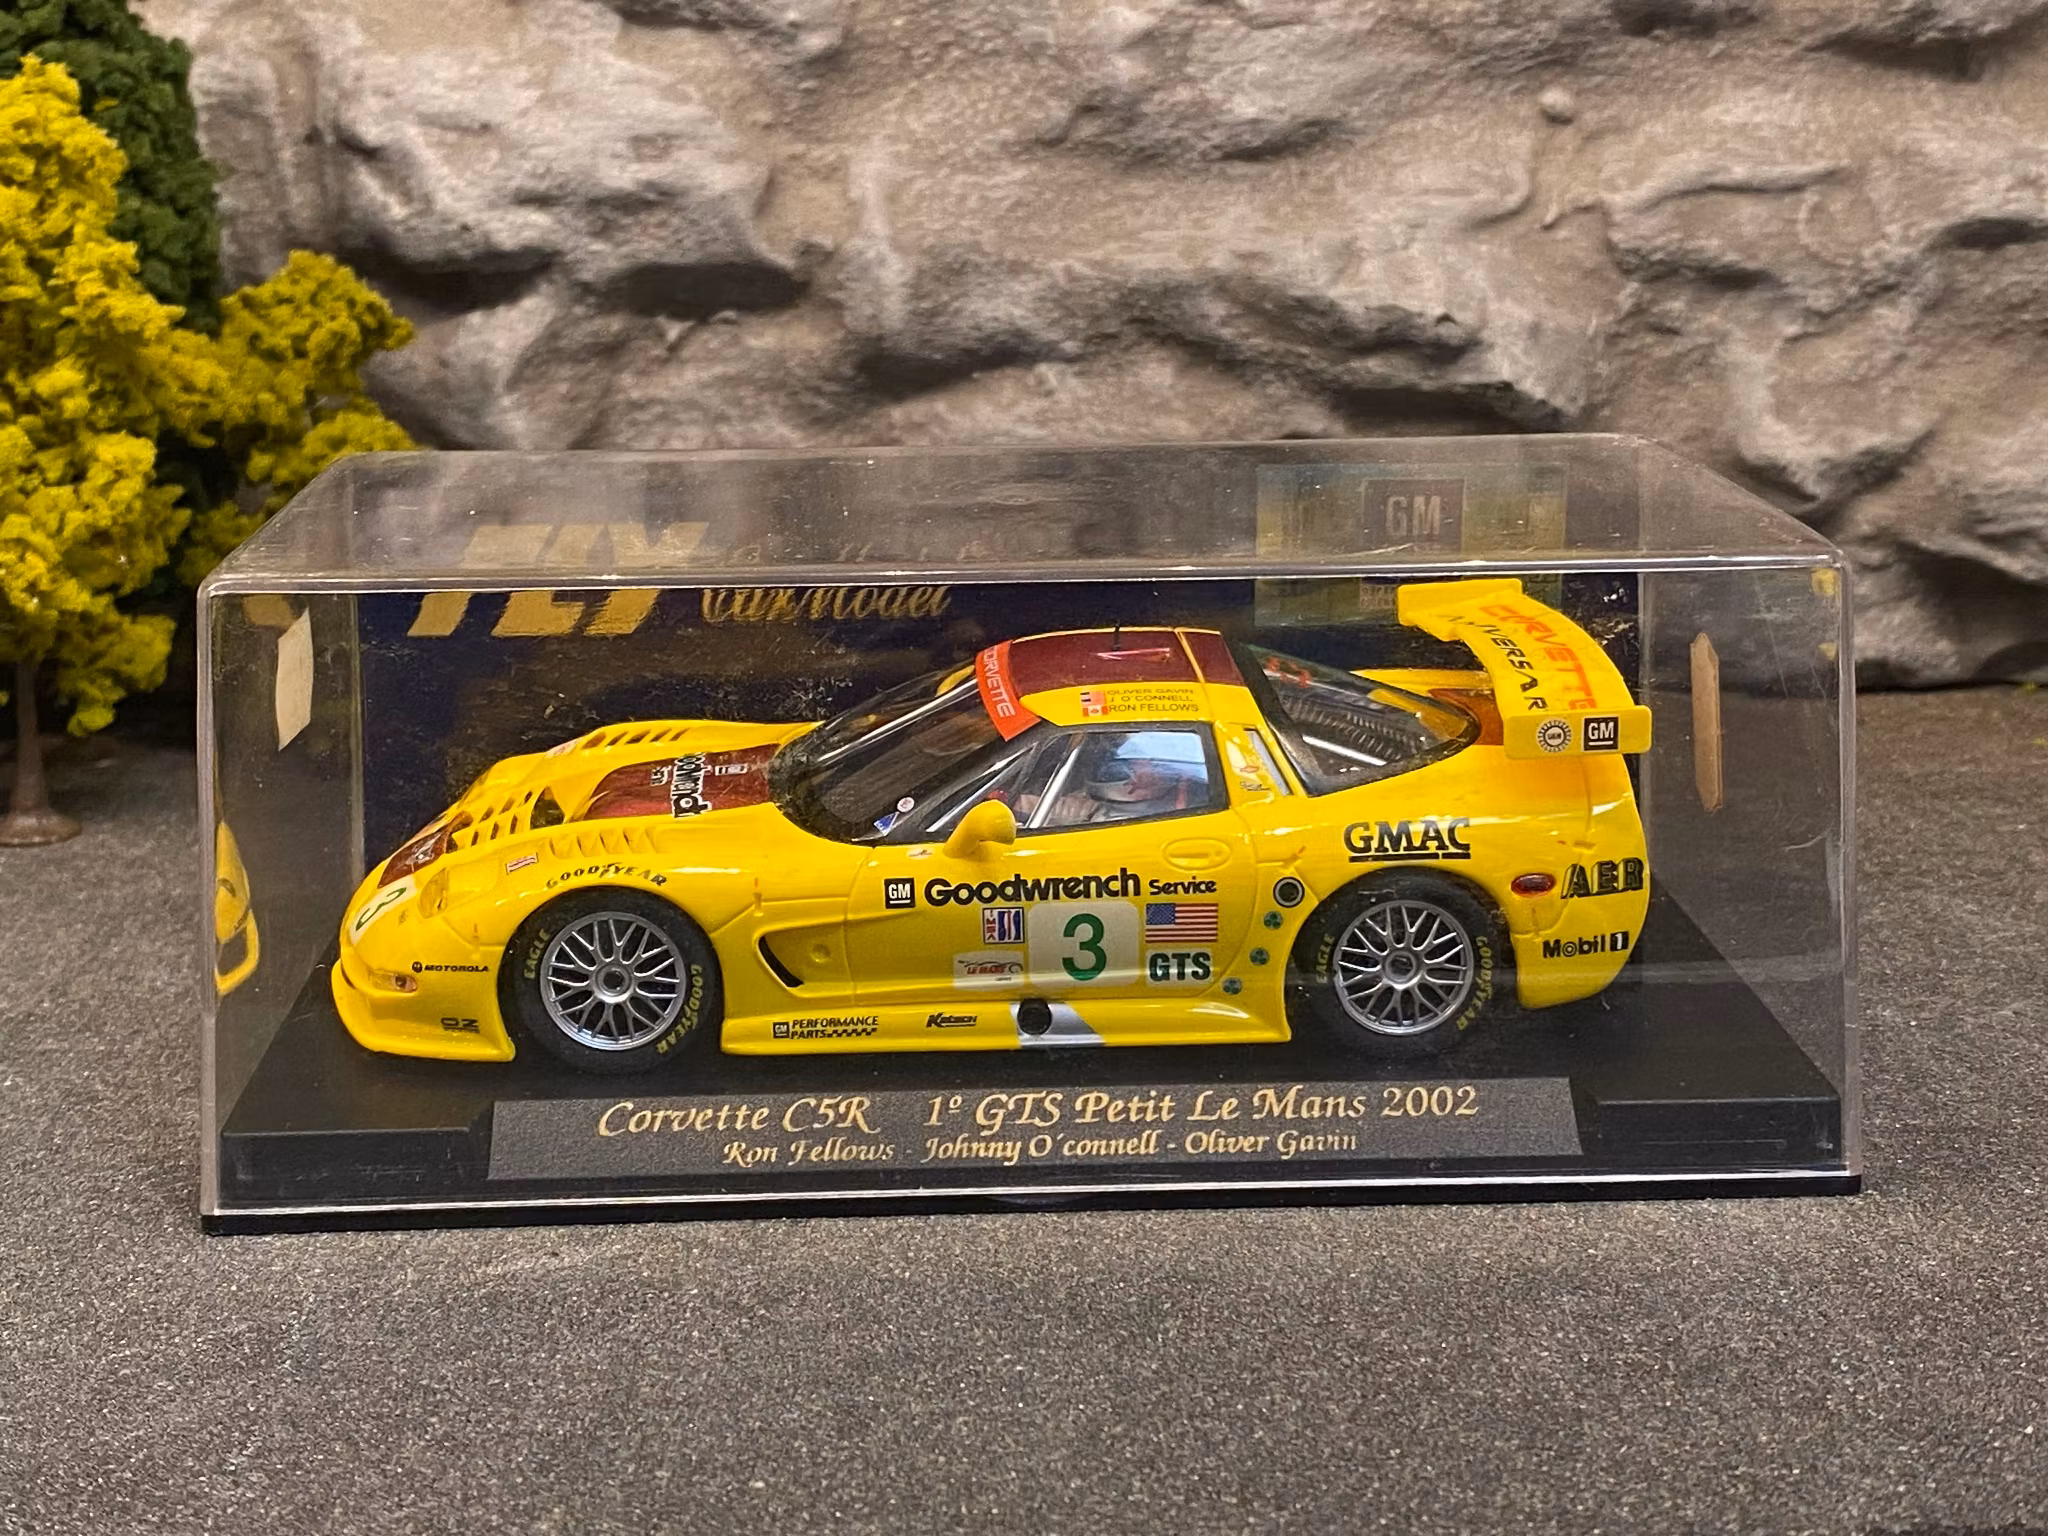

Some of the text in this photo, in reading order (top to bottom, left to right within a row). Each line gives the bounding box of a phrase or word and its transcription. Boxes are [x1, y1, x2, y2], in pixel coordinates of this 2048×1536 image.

[1386, 496, 1441, 537] GM
[1109, 704, 1199, 712] RON FELLOWS
[1588, 721, 1615, 740] GM
[1343, 818, 1471, 854] GMAC
[888, 883, 911, 898] GM
[924, 868, 1217, 906] Goodwrench Service
[1560, 857, 1644, 899] AER
[355, 887, 407, 931] 3
[524, 929, 550, 980] EAGLE
[1062, 913, 1107, 981] 3
[1148, 953, 1211, 981] GTS
[1316, 933, 1336, 984] EAGLE
[1543, 936, 1605, 958] Mobil
[1456, 935, 1493, 1031] GOODYEAR
[656, 964, 703, 1054] GOODYEAR
[793, 1016, 879, 1029] PERFORMANCE
[791, 1029, 827, 1039] PARTS
[598, 1101, 770, 1137] Corvette
[782, 1095, 881, 1134] C5R
[975, 1090, 1064, 1137] GTS
[1074, 1089, 1176, 1123] Petit
[1187, 1089, 1240, 1122] Le
[1252, 1084, 1367, 1120] Mans
[1381, 1085, 1480, 1117] 2002
[722, 1141, 778, 1168] Ron
[788, 1136, 895, 1166] Fellows
[919, 1132, 1022, 1166] Johnny
[1184, 1128, 1270, 1154] Oliver
[1276, 1129, 1358, 1160] Gavin
